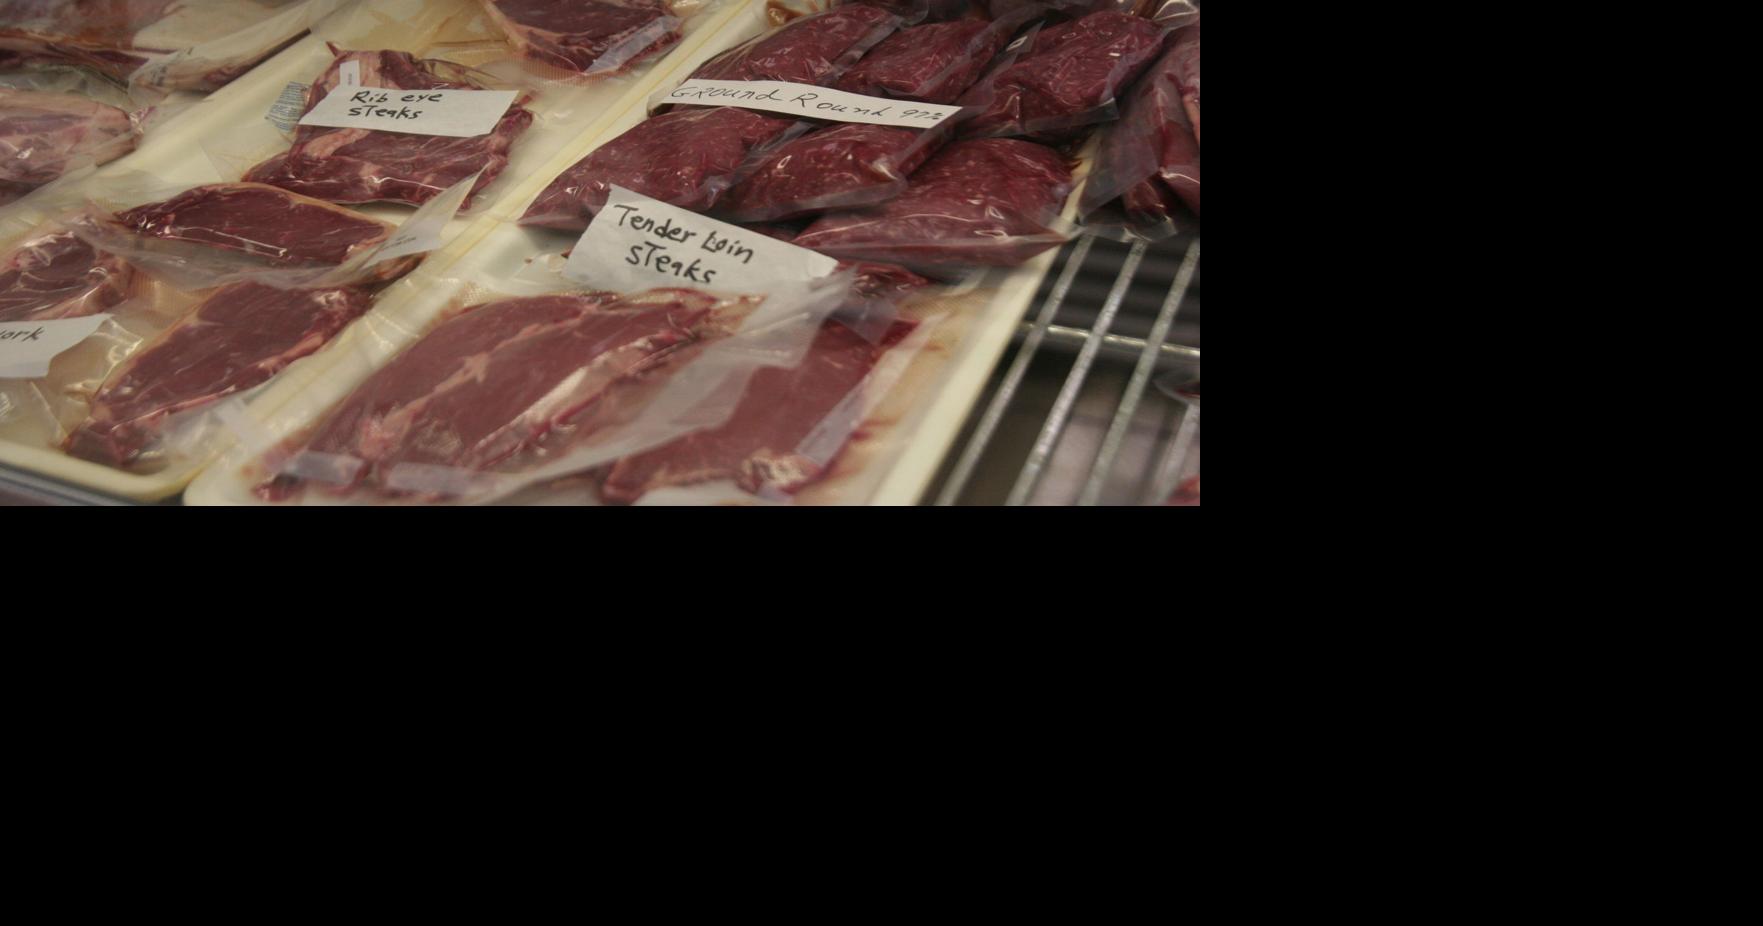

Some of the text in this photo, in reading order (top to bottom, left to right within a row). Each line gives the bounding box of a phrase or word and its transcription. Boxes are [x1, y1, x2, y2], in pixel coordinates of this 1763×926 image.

[349, 90, 444, 104] Rib eye
[789, 92, 893, 117] Round
[613, 204, 698, 243] Tender
